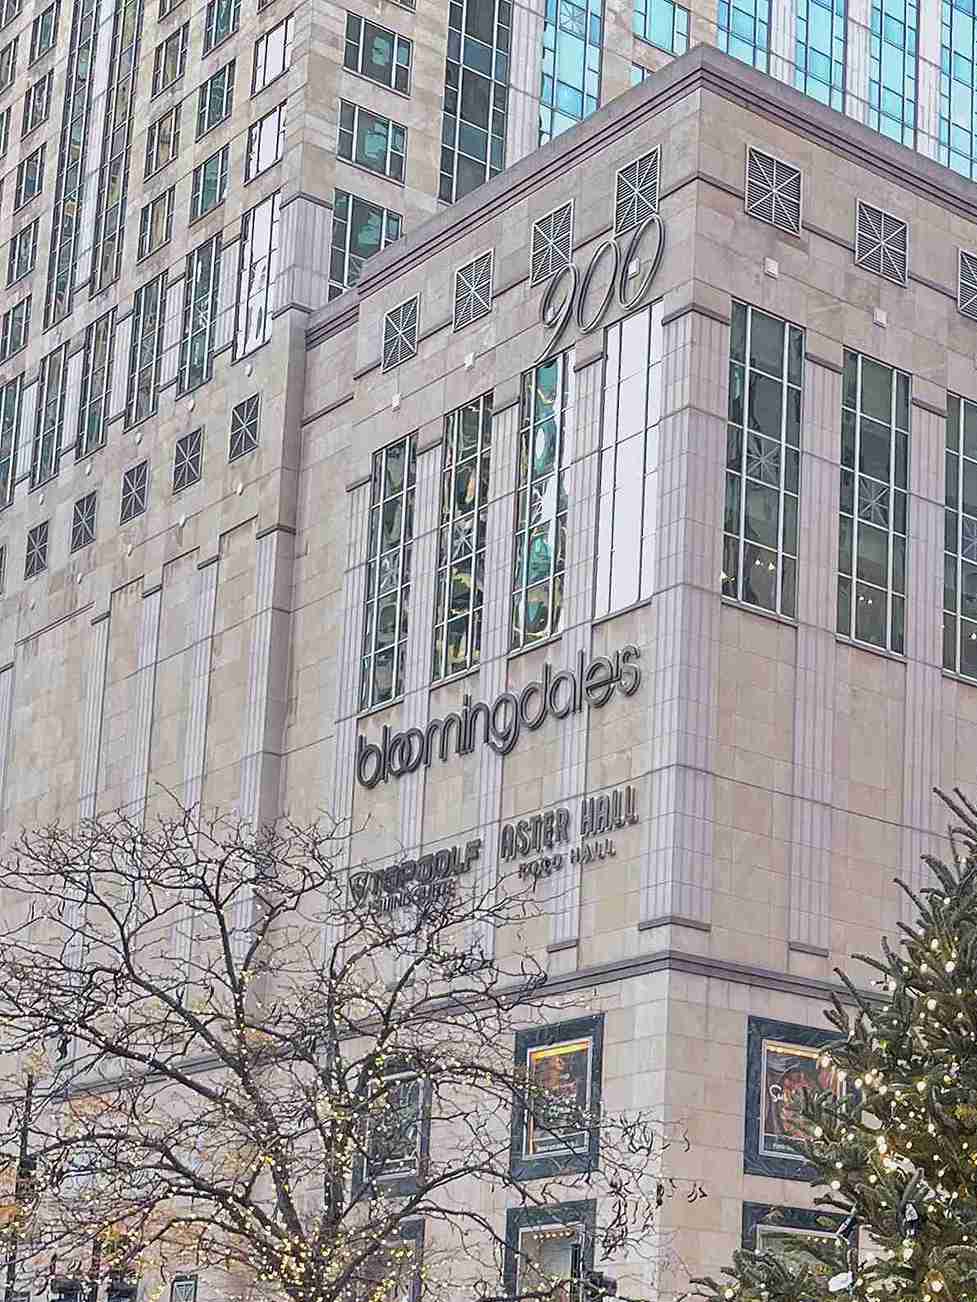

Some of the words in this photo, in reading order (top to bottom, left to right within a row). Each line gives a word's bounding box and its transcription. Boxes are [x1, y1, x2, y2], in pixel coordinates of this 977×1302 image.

[537, 214, 665, 365] 900
[500, 807, 570, 861] ASTER
[580, 785, 639, 836] HALL
